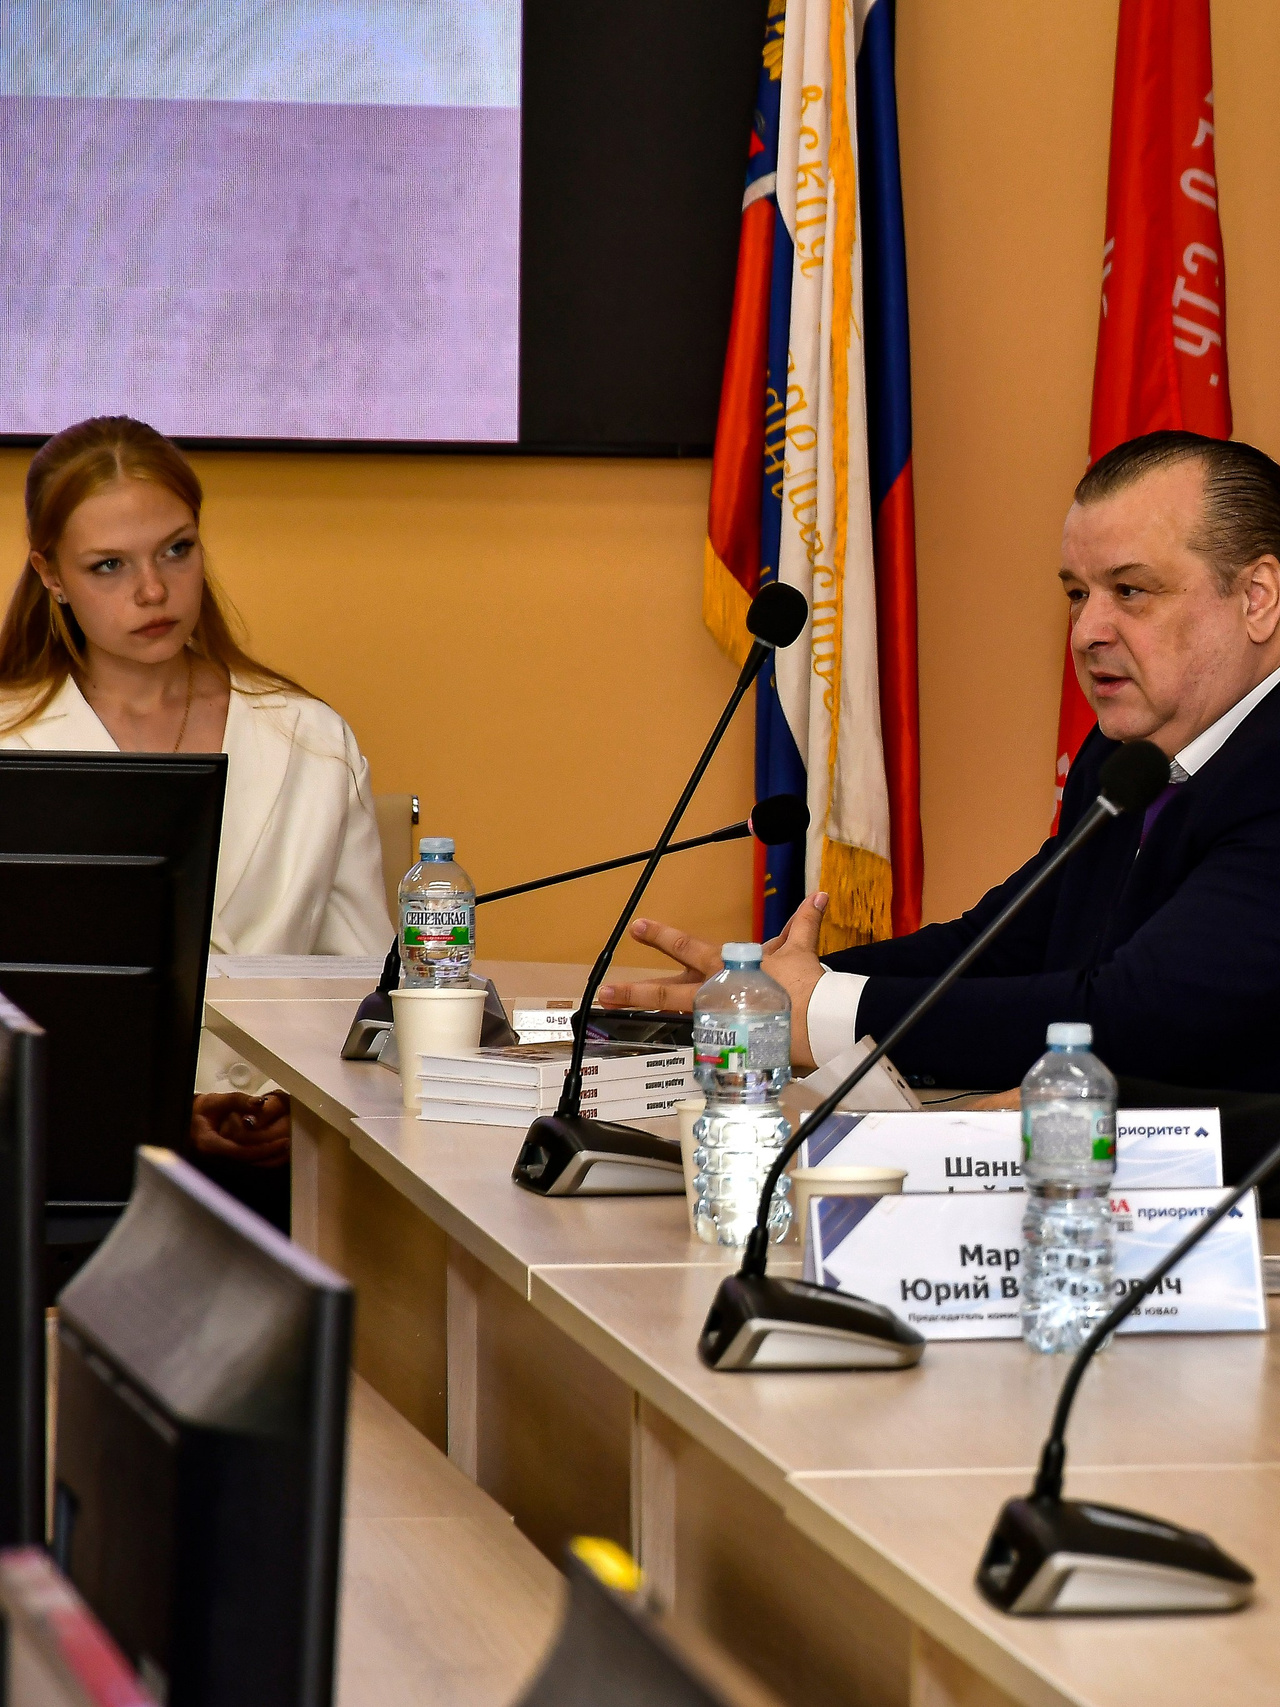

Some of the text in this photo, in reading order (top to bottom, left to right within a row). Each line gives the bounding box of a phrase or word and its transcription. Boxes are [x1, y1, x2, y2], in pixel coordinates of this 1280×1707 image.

[406, 912, 466, 925] СЕНЕЖСКАЯ
[1117, 1125, 1190, 1137] риоритет
[945, 1157, 1022, 1177] Шань
[1138, 1207, 1217, 1220] приорите
[960, 1244, 1020, 1271] Мар
[901, 1276, 990, 1304] Юрий
